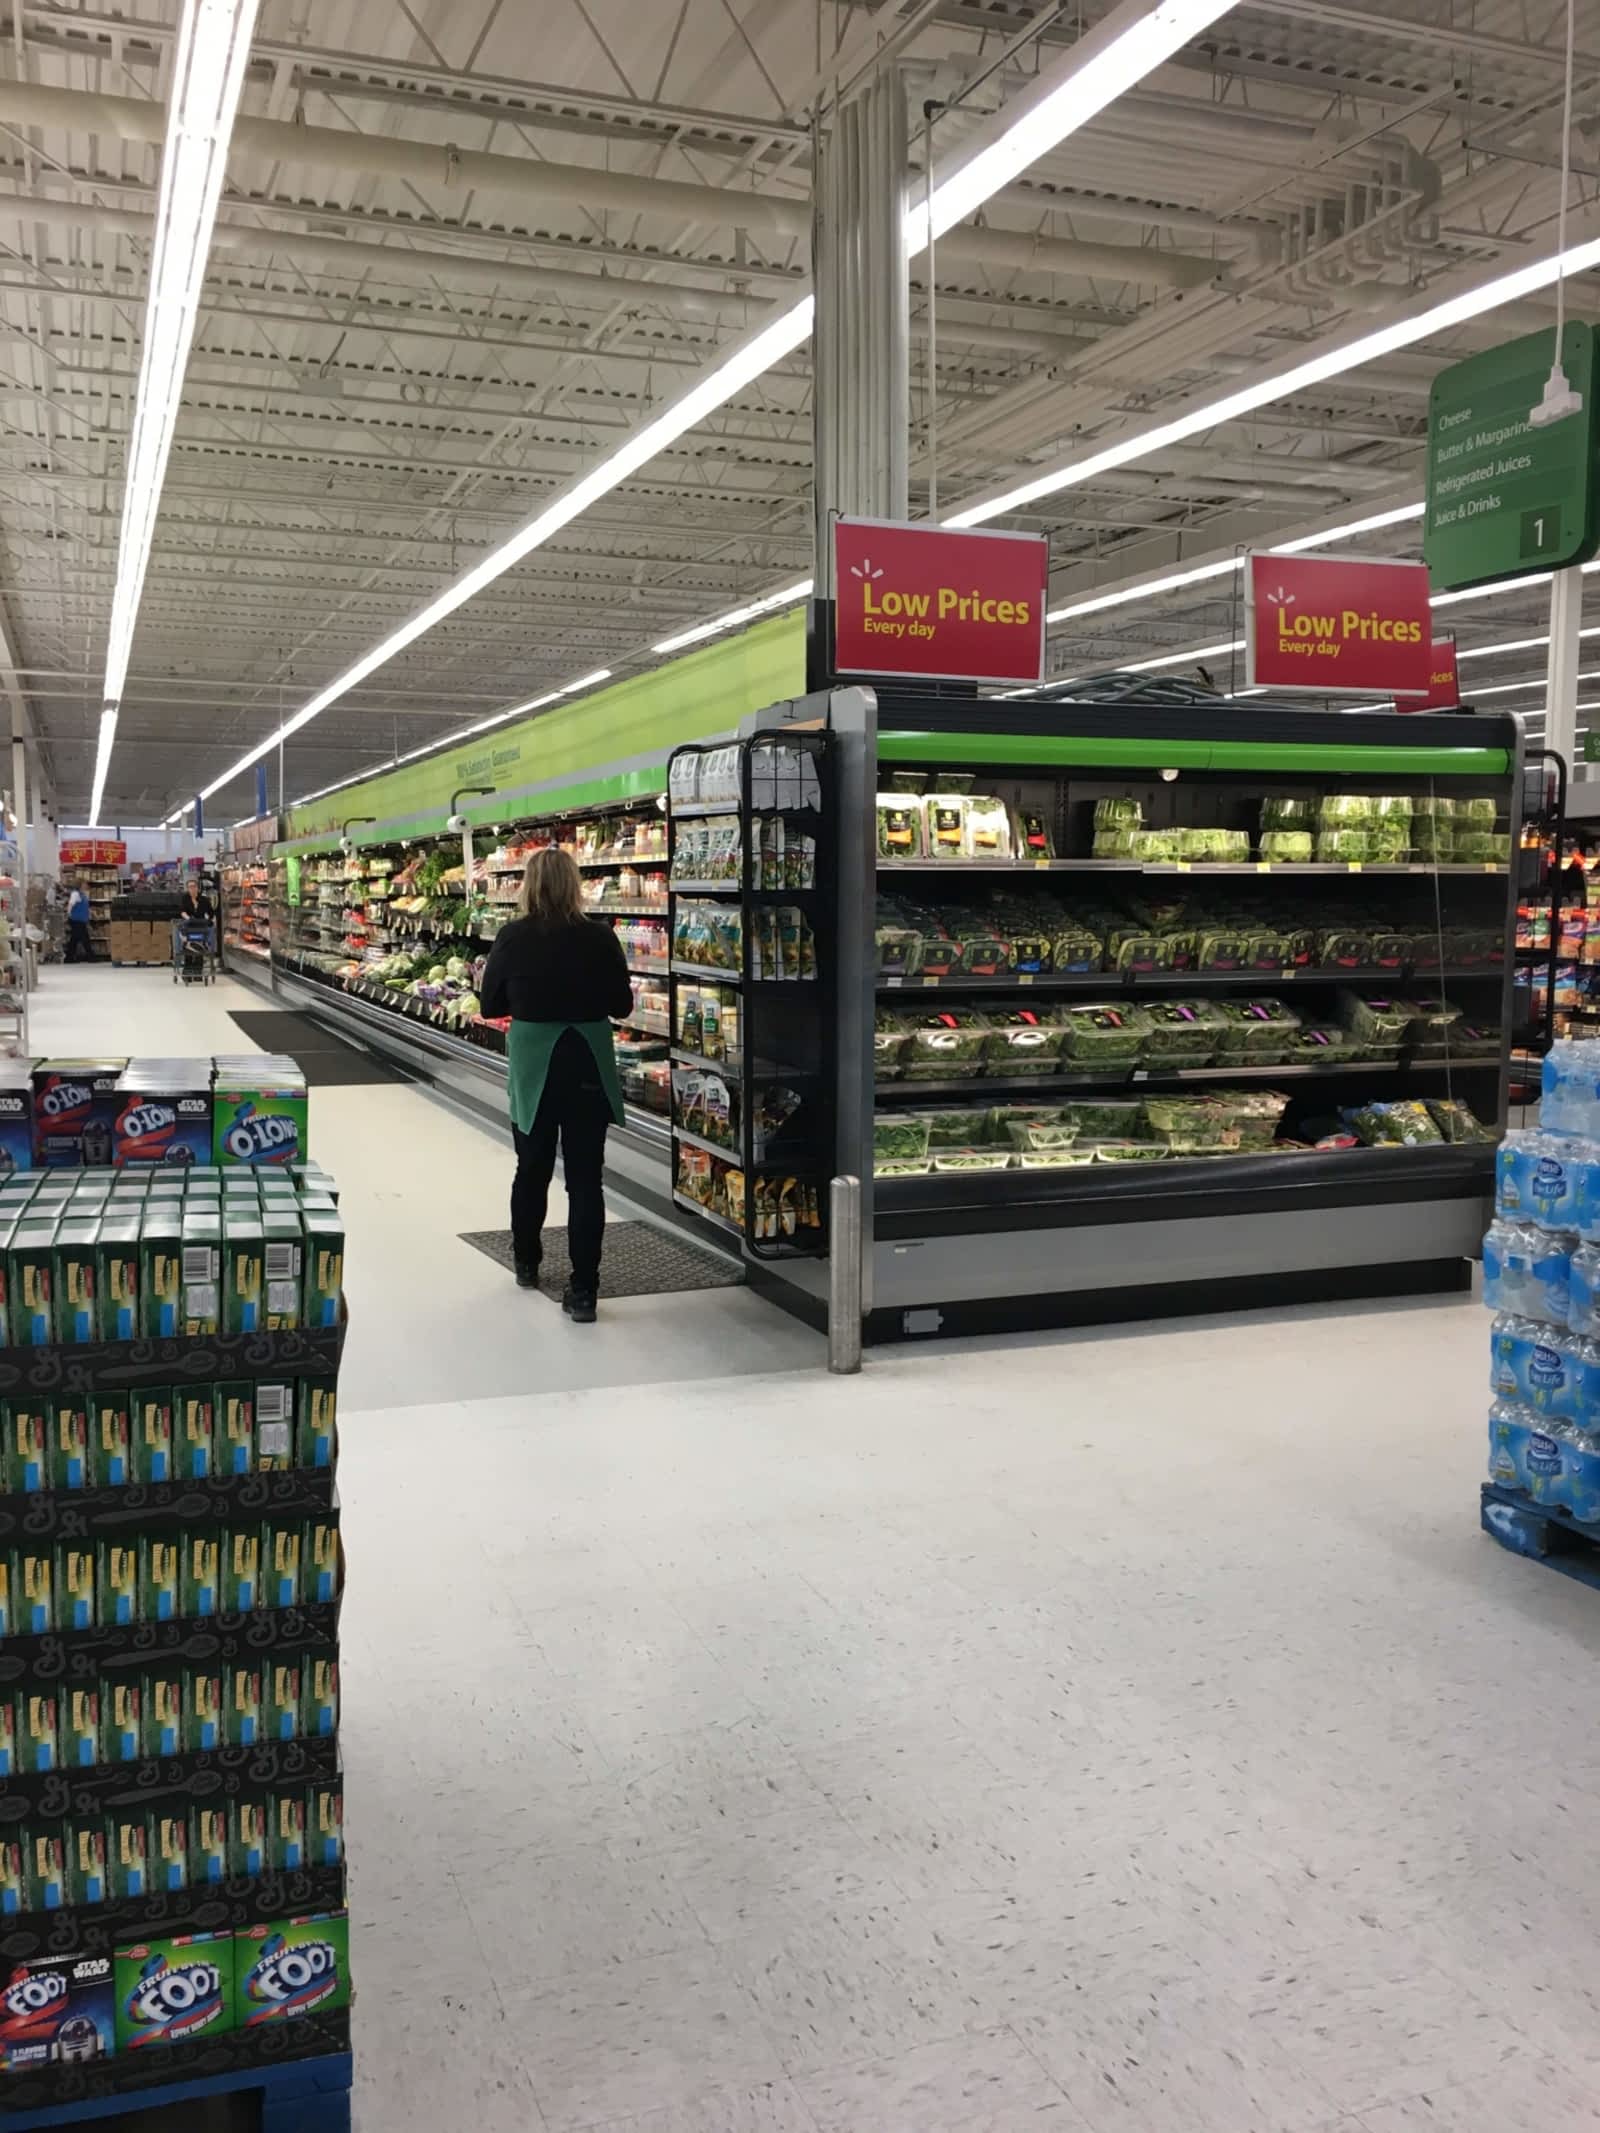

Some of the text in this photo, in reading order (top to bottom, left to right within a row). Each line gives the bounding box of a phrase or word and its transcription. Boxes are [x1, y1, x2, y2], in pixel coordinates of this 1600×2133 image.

[1439, 408, 1472, 431] Cheese
[1437, 441, 1464, 463] Butter
[1465, 437, 1473, 451] &
[1435, 454, 1532, 495] Refrigerated Juices
[1434, 494, 1501, 528] Juice & Drinks
[1534, 518, 1544, 547] 1
[863, 582, 1029, 624] Low Prices
[863, 617, 936, 640] Every day
[1279, 607, 1422, 642] Low Prices
[1279, 639, 1341, 658] Every day
[1431, 671, 1454, 684] rices
[230, 1119, 298, 1157] O-LONG
[72, 1966, 108, 1979] WARS
[77, 1958, 110, 1970] STAR
[257, 1944, 299, 1973] FRUIT
[258, 1946, 336, 2000] FOOT
[138, 1965, 180, 1994] FRUIT
[7, 1976, 67, 2016] FOOT
[140, 1967, 220, 2023] FOOT
